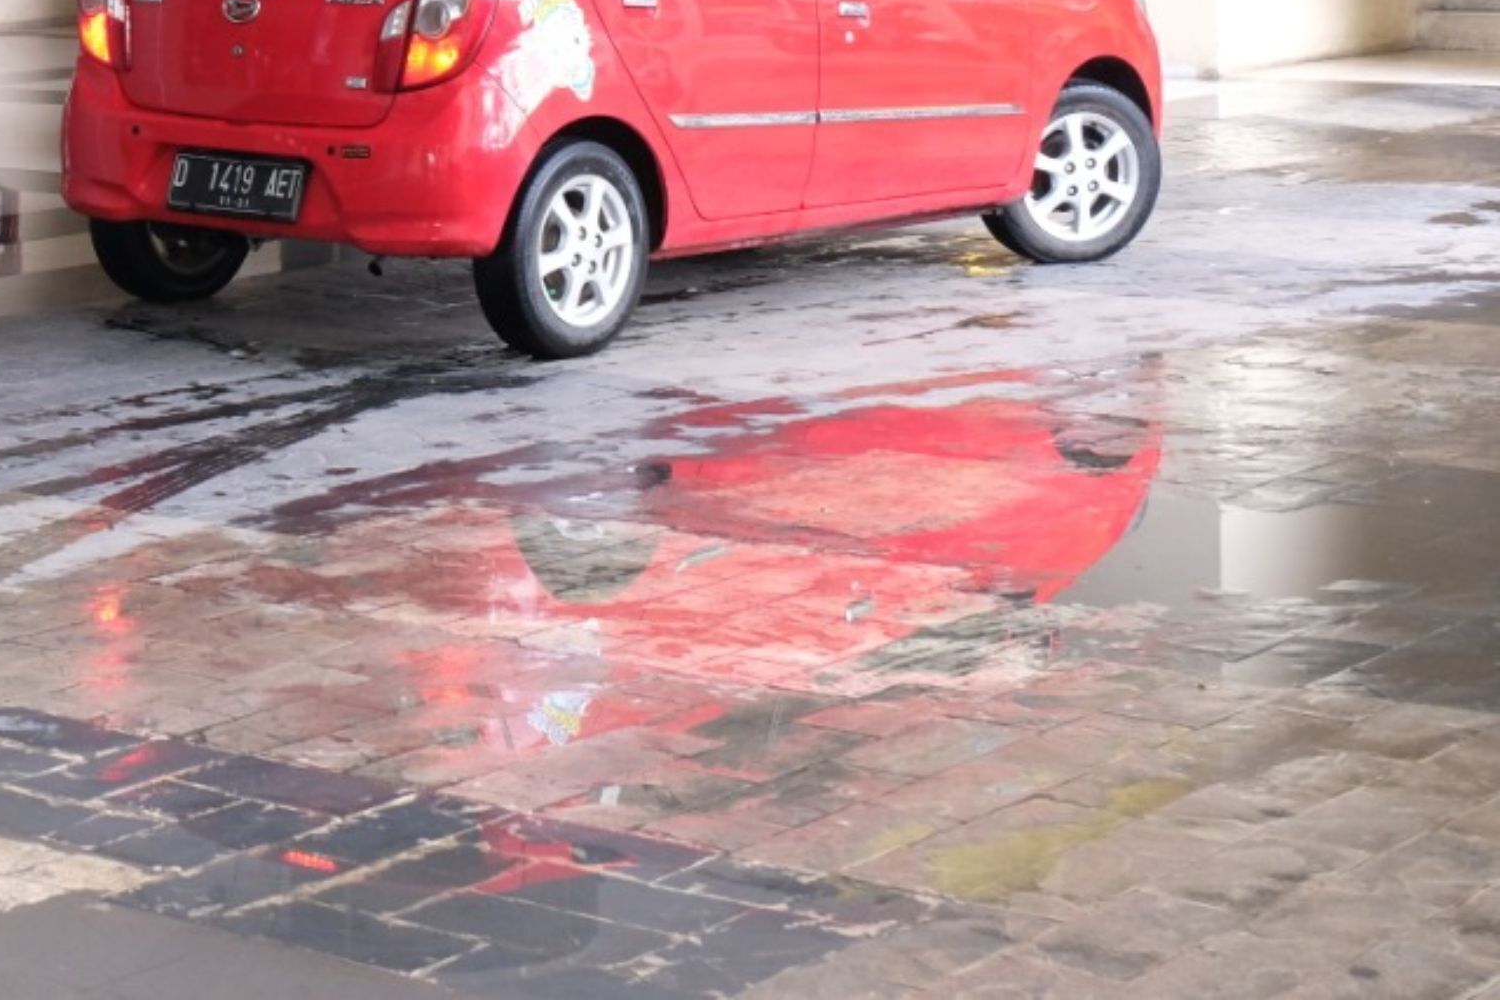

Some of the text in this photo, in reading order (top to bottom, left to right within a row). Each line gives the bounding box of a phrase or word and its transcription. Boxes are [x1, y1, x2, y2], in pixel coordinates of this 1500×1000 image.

[173, 158, 303, 199] D 1419 AET
